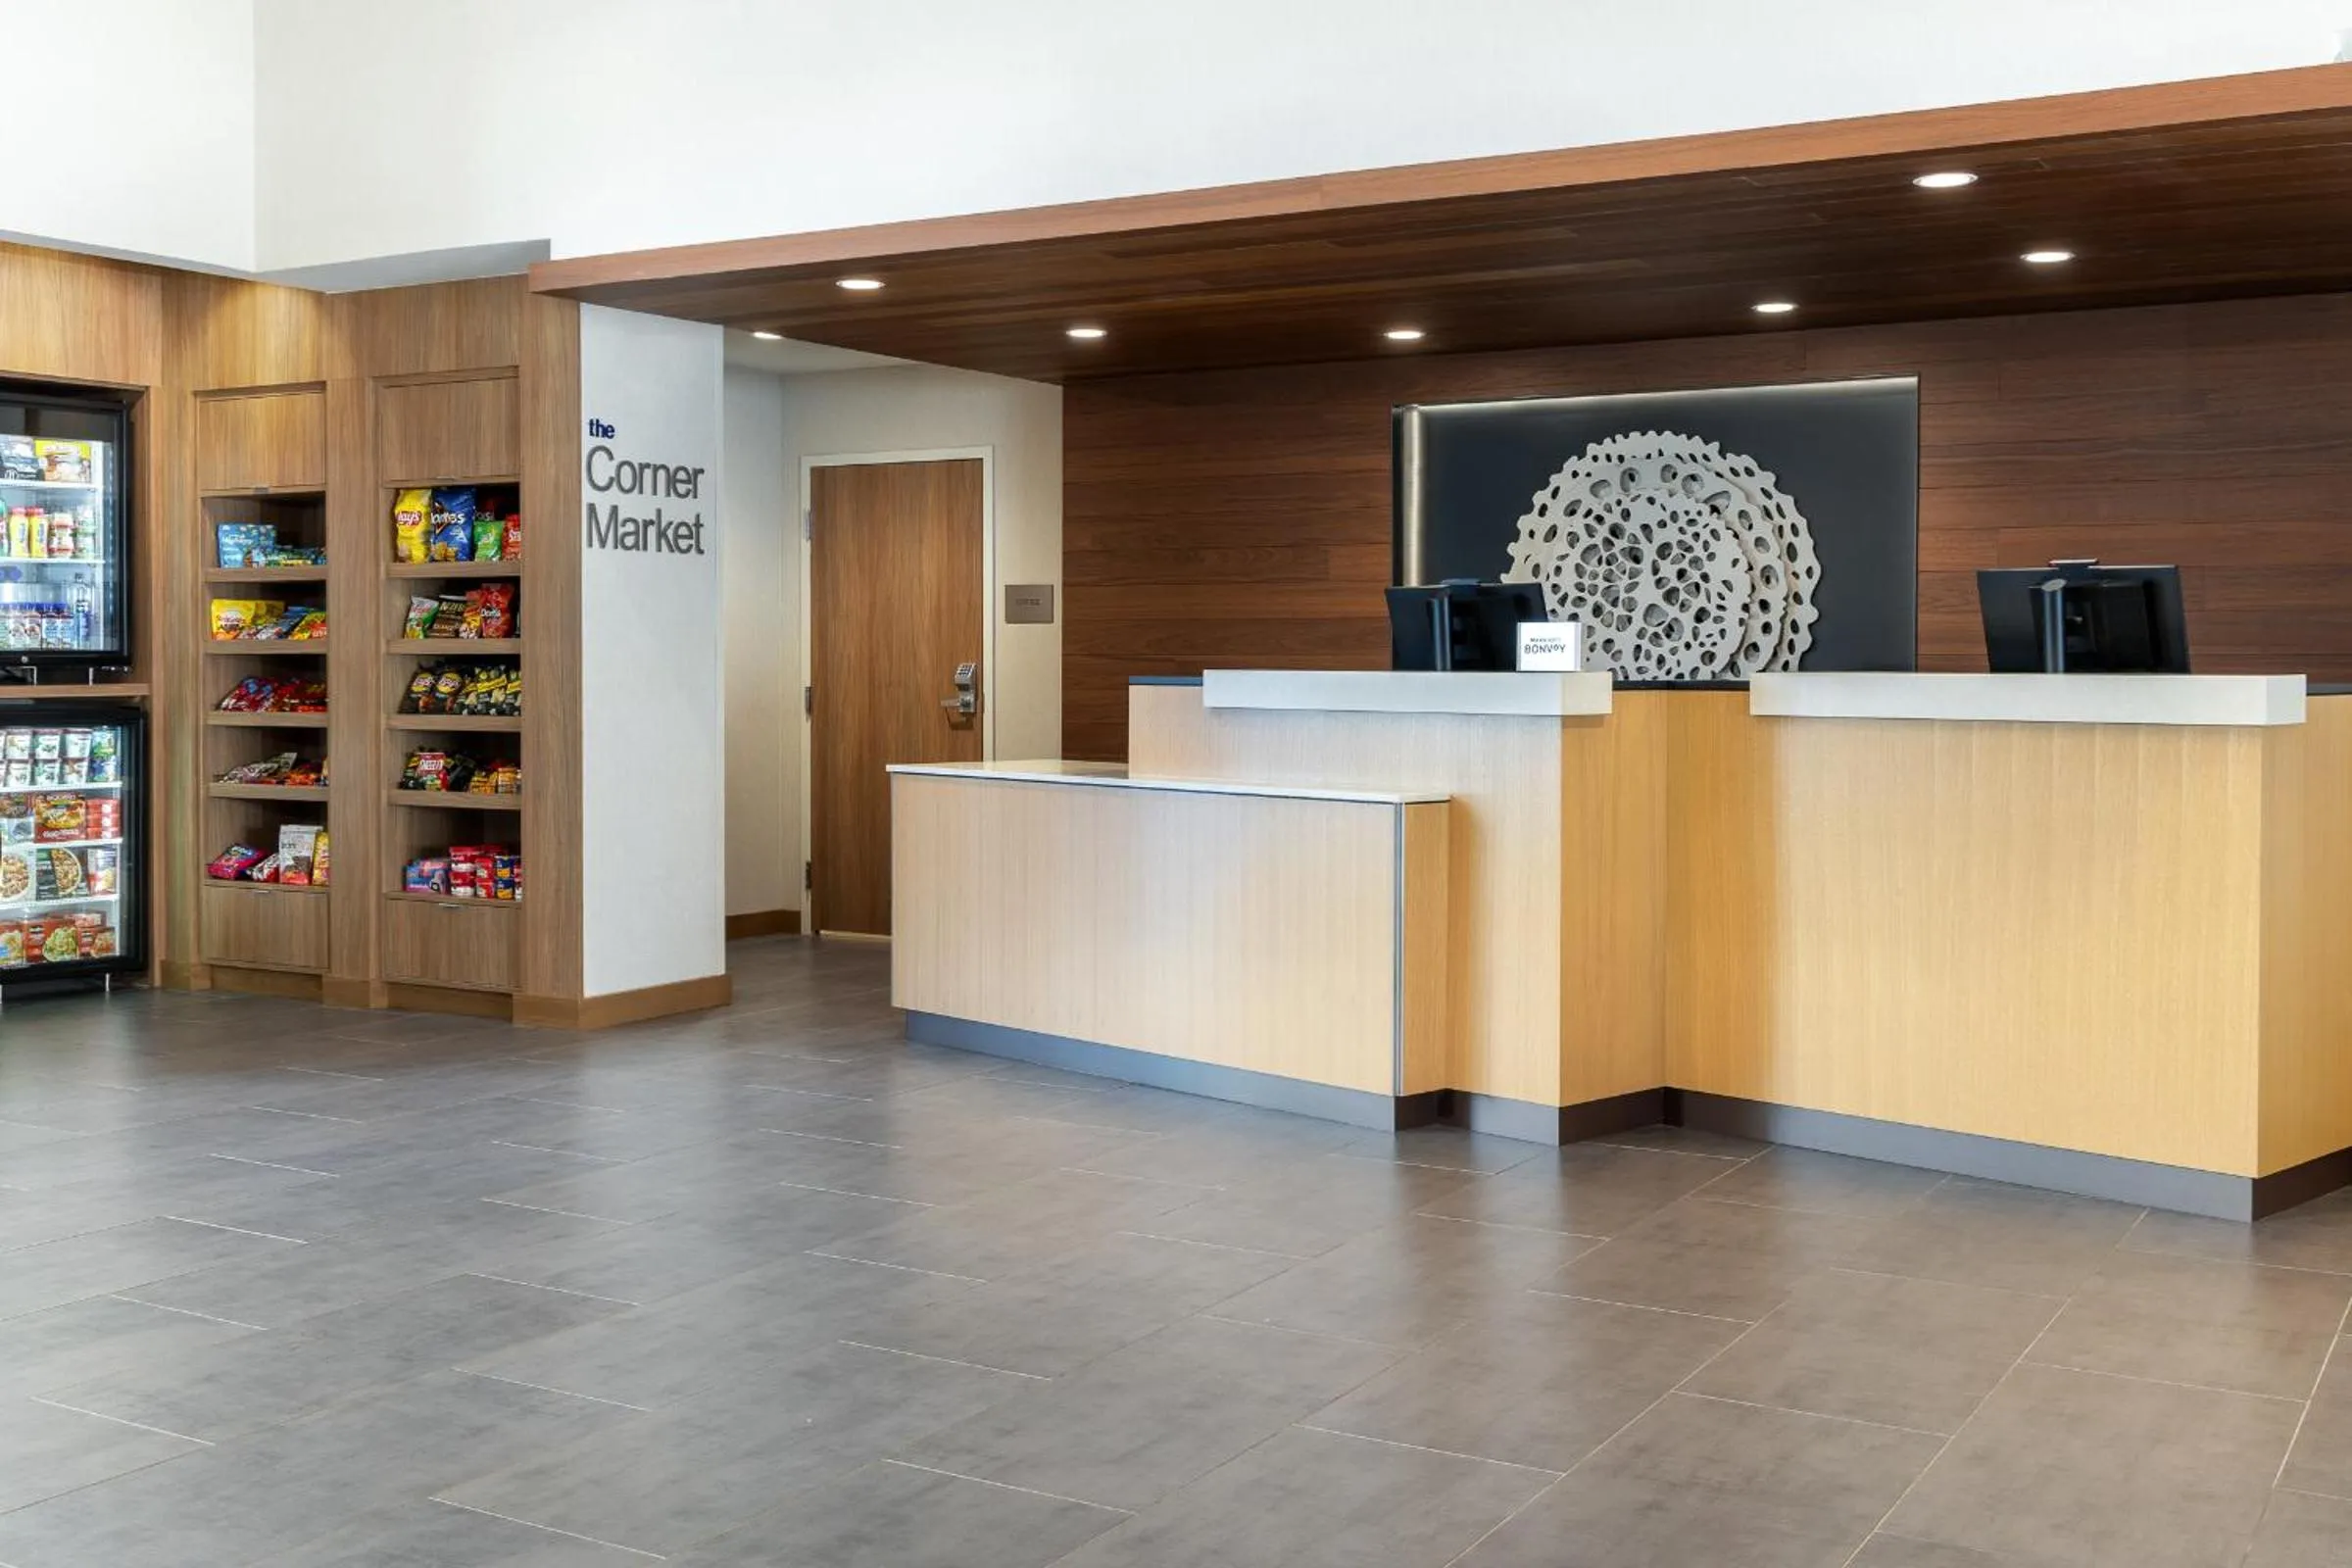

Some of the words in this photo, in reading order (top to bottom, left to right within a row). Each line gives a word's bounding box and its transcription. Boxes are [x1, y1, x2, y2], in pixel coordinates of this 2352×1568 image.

[588, 418, 615, 439] the
[586, 445, 705, 499] Corner
[586, 502, 705, 555] Market
[1524, 643, 1566, 655] BONVOY
